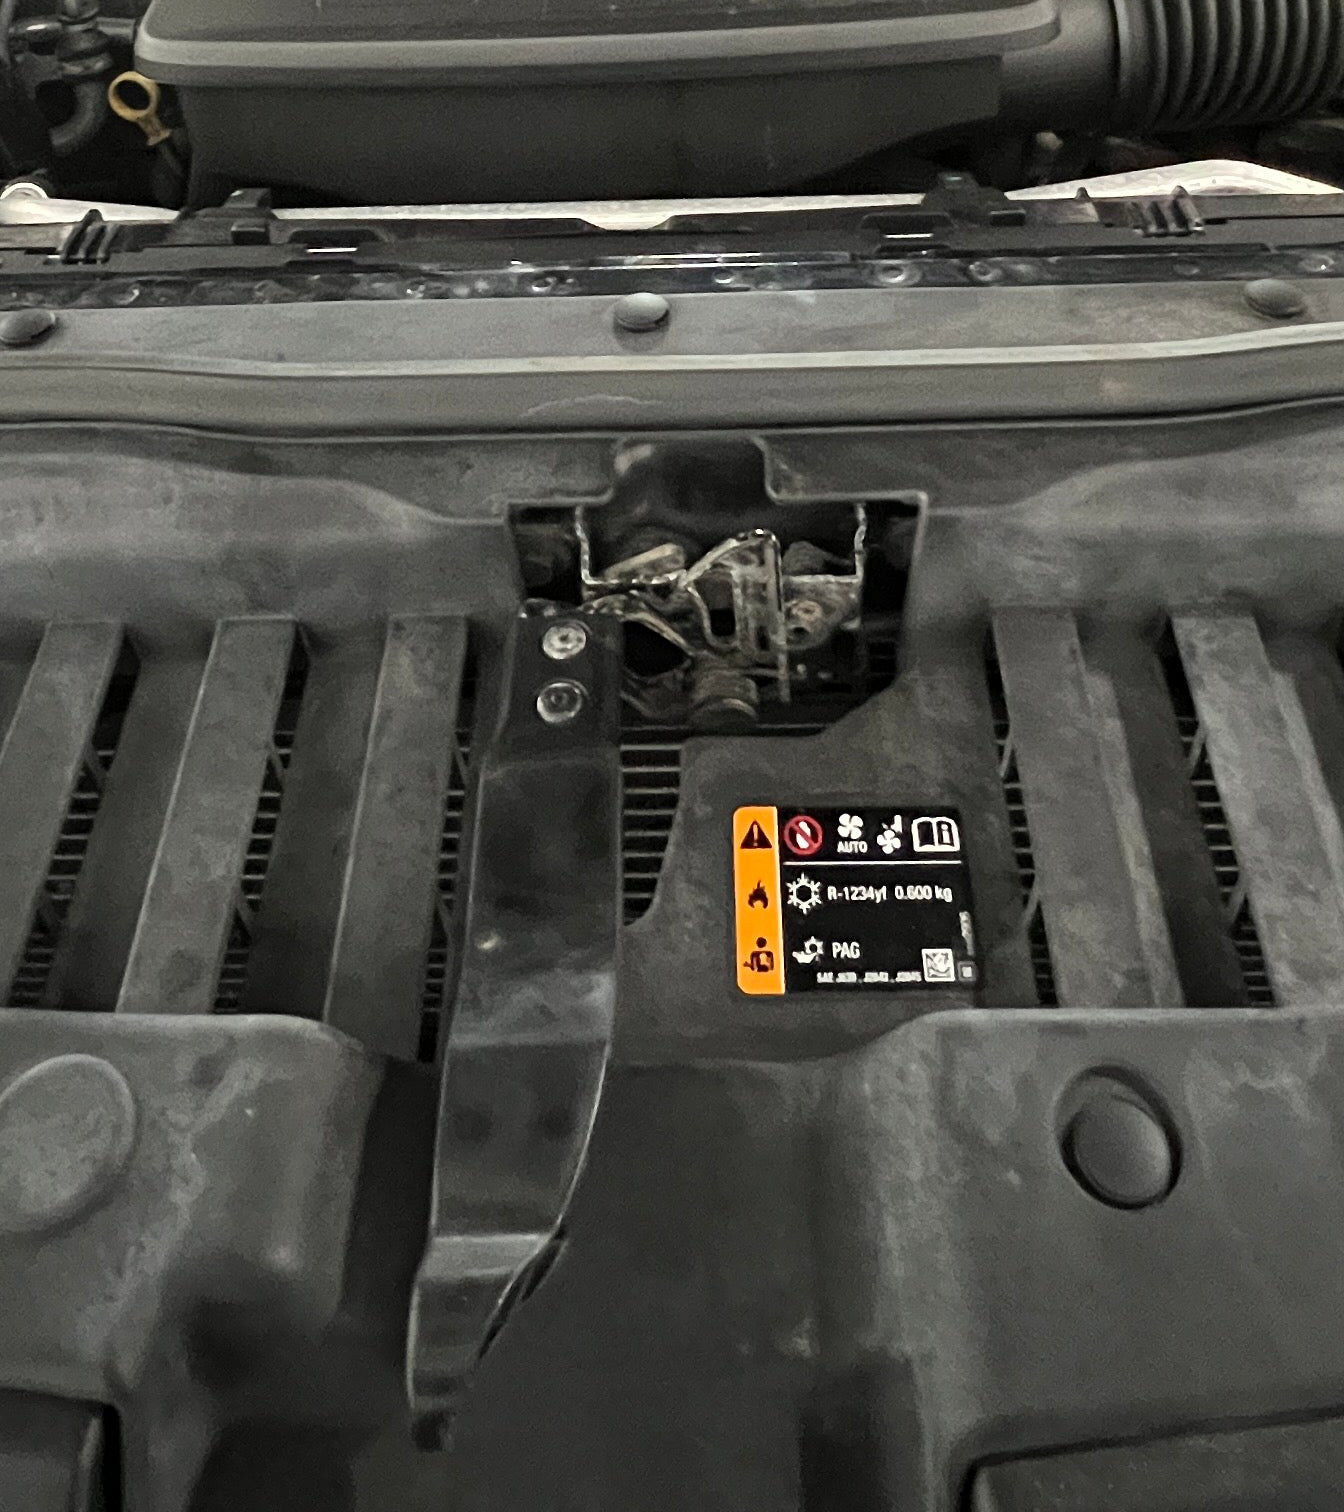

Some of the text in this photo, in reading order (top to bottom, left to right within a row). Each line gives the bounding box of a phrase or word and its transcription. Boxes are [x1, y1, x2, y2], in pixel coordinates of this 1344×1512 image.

[837, 841, 868, 853] AUTO
[935, 885, 953, 903] kg
[831, 941, 860, 959] PAG
